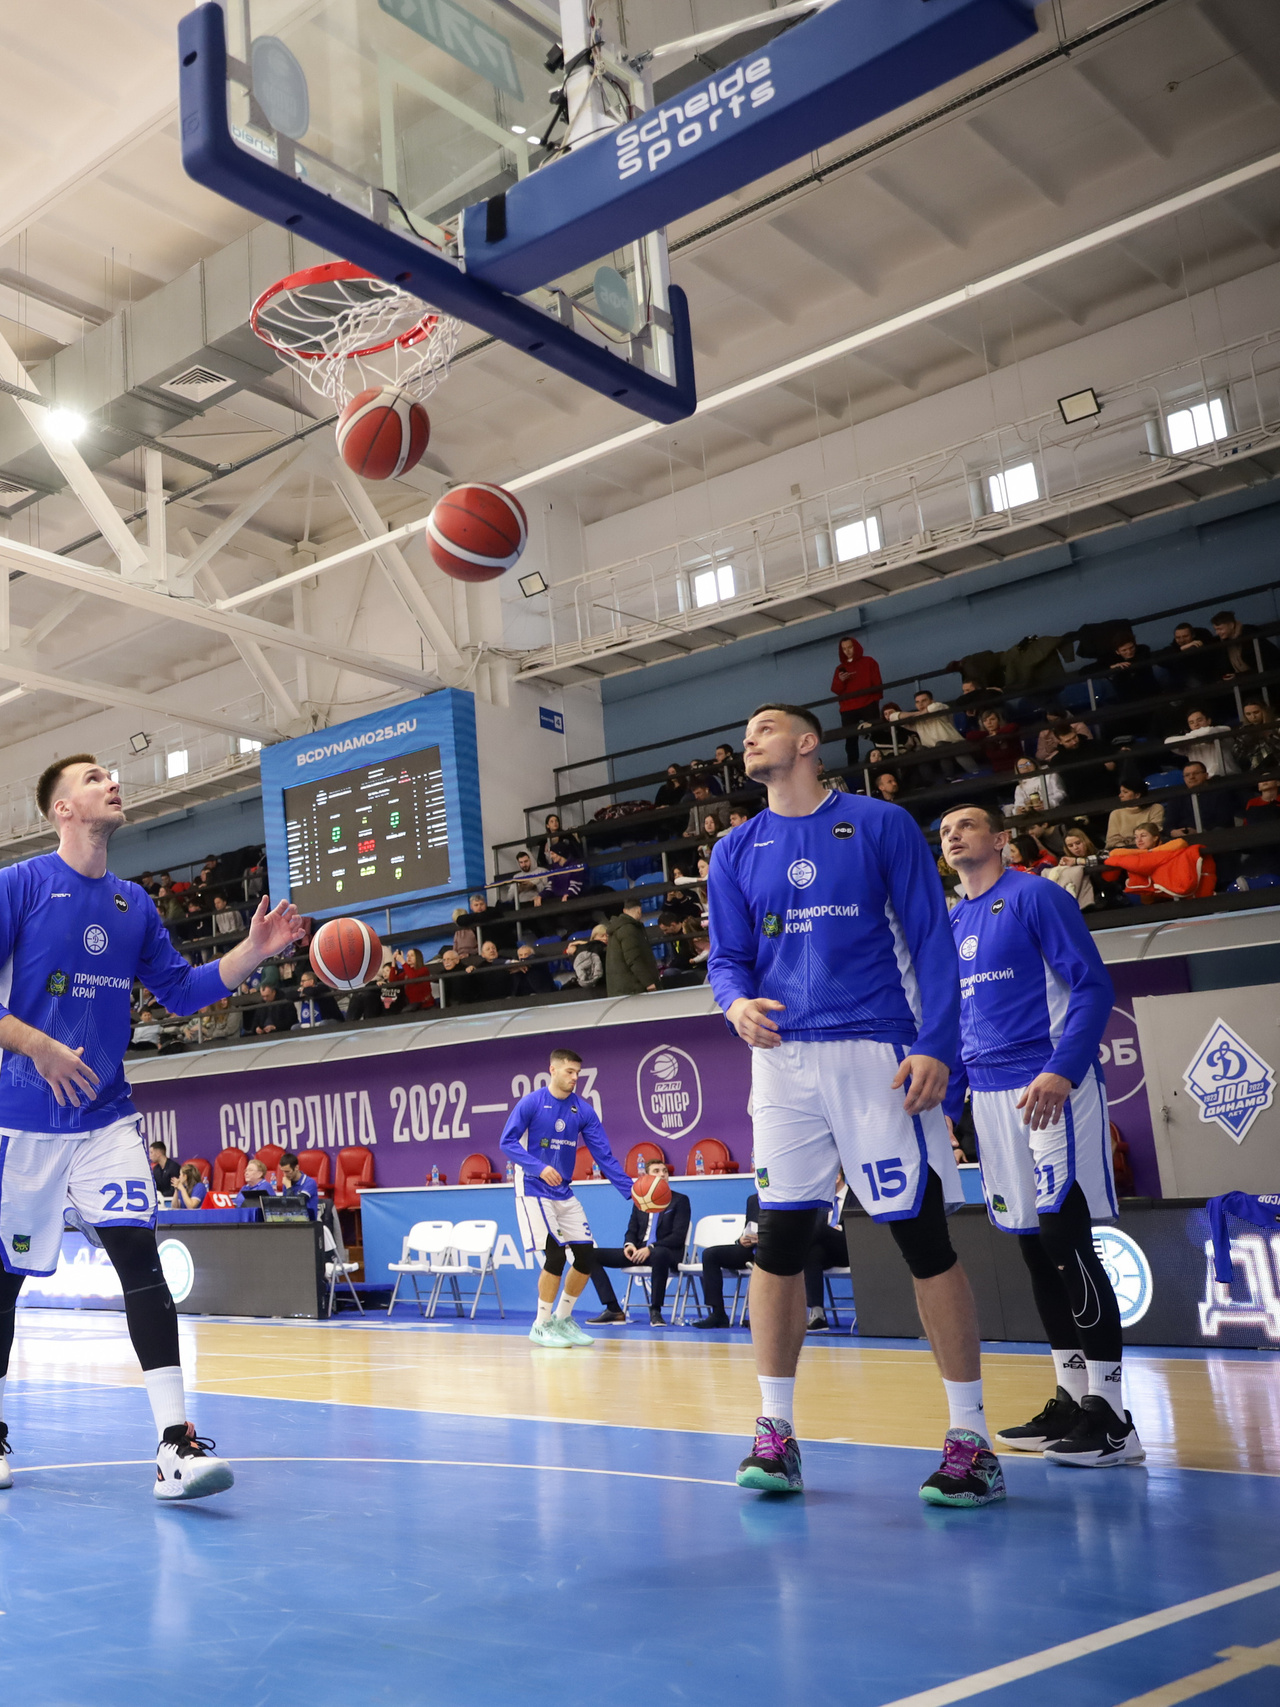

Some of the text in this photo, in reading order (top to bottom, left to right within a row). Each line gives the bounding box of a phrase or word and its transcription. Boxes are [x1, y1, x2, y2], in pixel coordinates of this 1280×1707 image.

[616, 57, 772, 157] Schelde
[617, 80, 776, 180] Sports
[296, 718, 418, 767] BCDYNAMO25.RU
[785, 903, 860, 921] ПРИМОРСКИЙ
[785, 919, 813, 934] КРАЙ
[72, 986, 96, 999] КРАЙ
[73, 972, 131, 990] ПРИМОРСКИЙ
[1203, 1093, 1218, 1103] 1923
[1217, 1081, 1248, 1105] 100
[1248, 1081, 1265, 1093] 2023
[650, 1091, 690, 1114] СУПЕР
[1205, 1094, 1267, 1117] ДИНАМО
[1227, 1109, 1244, 1118] ЛЕТ
[219, 1090, 378, 1153] СУПЕРЛИГА
[661, 1113, 684, 1129] ЛИГА
[861, 1157, 908, 1202] 15
[100, 1180, 151, 1213] 25
